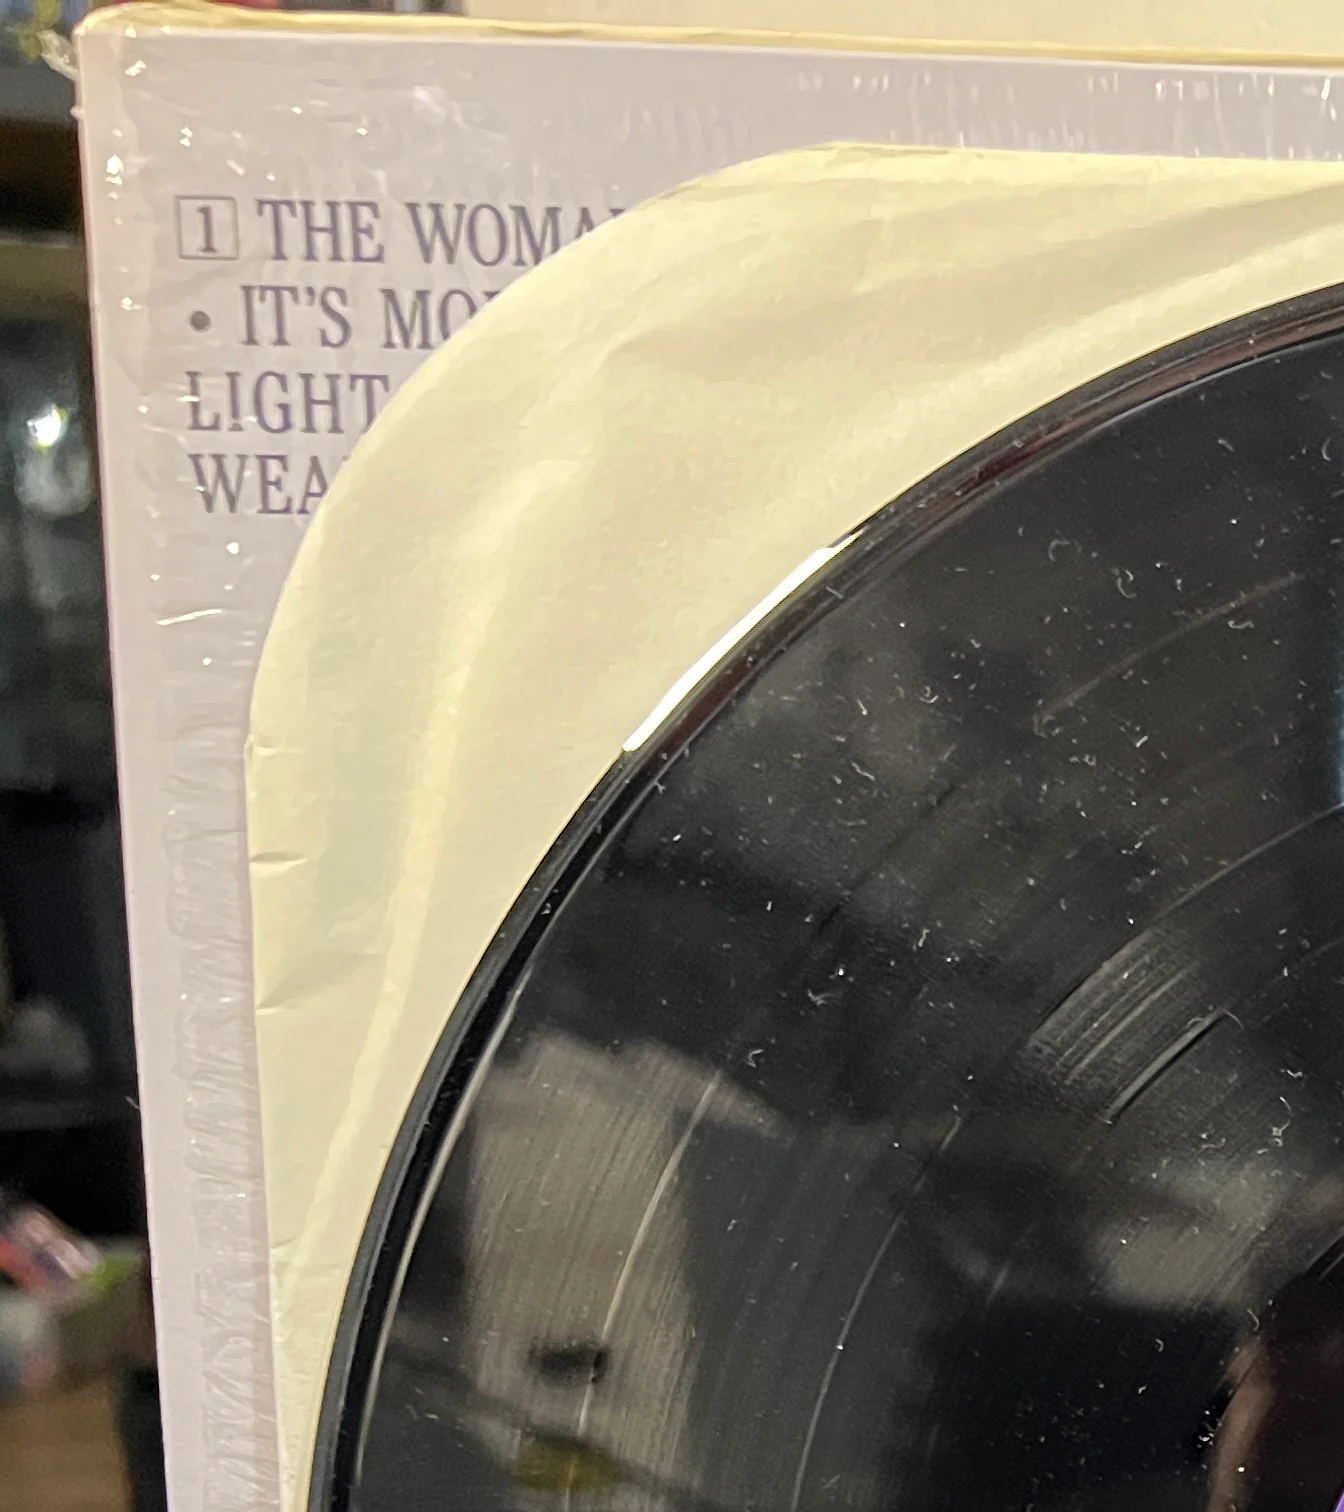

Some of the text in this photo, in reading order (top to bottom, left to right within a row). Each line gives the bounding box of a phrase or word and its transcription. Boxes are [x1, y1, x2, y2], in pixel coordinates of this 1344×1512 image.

[258, 200, 384, 263] THE
[407, 203, 625, 266] WOMA
[240, 285, 500, 349] IT'S MO
[185, 371, 389, 434] LIGHT
[187, 453, 349, 515] WEA
